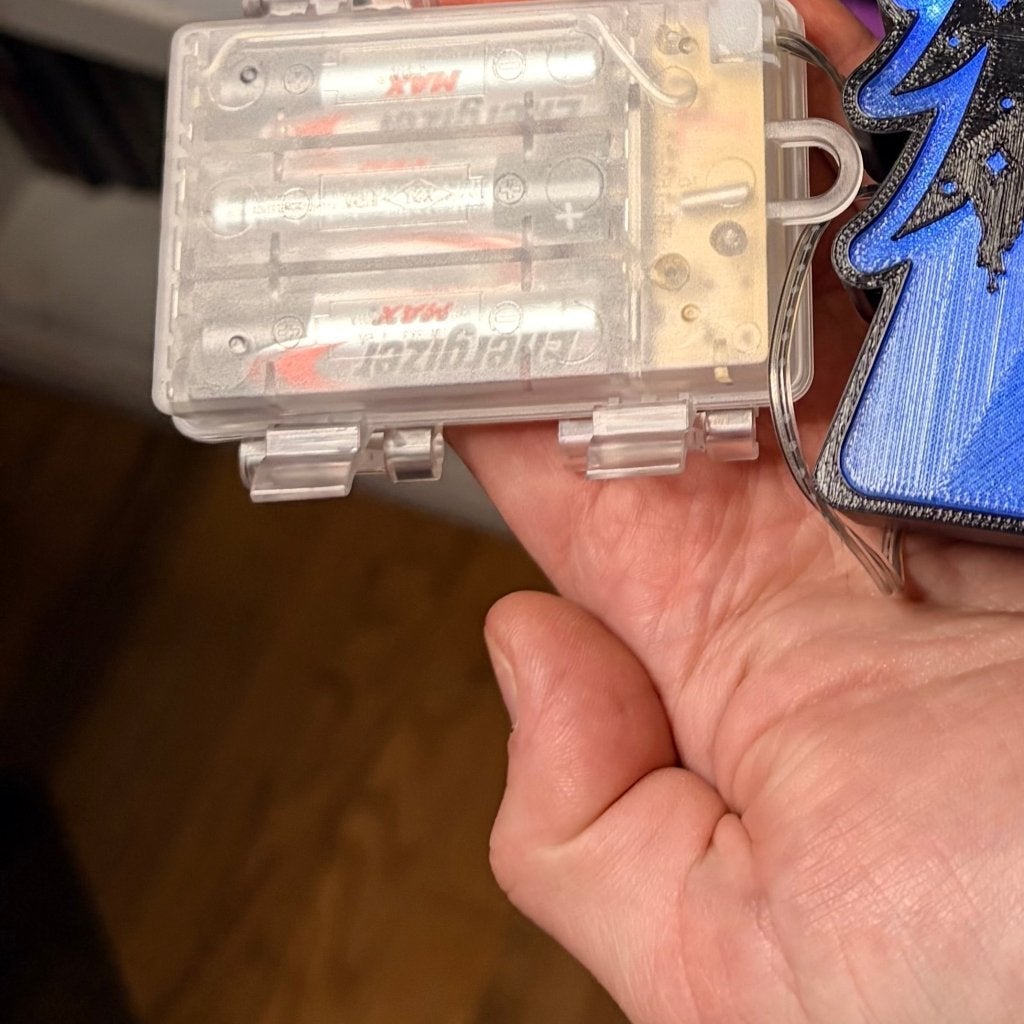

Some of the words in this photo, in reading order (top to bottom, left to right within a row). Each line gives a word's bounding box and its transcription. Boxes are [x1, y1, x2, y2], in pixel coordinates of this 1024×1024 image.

[385, 69, 462, 98] MAX
[376, 301, 453, 326] MAX
[350, 323, 582, 378] Energizer
